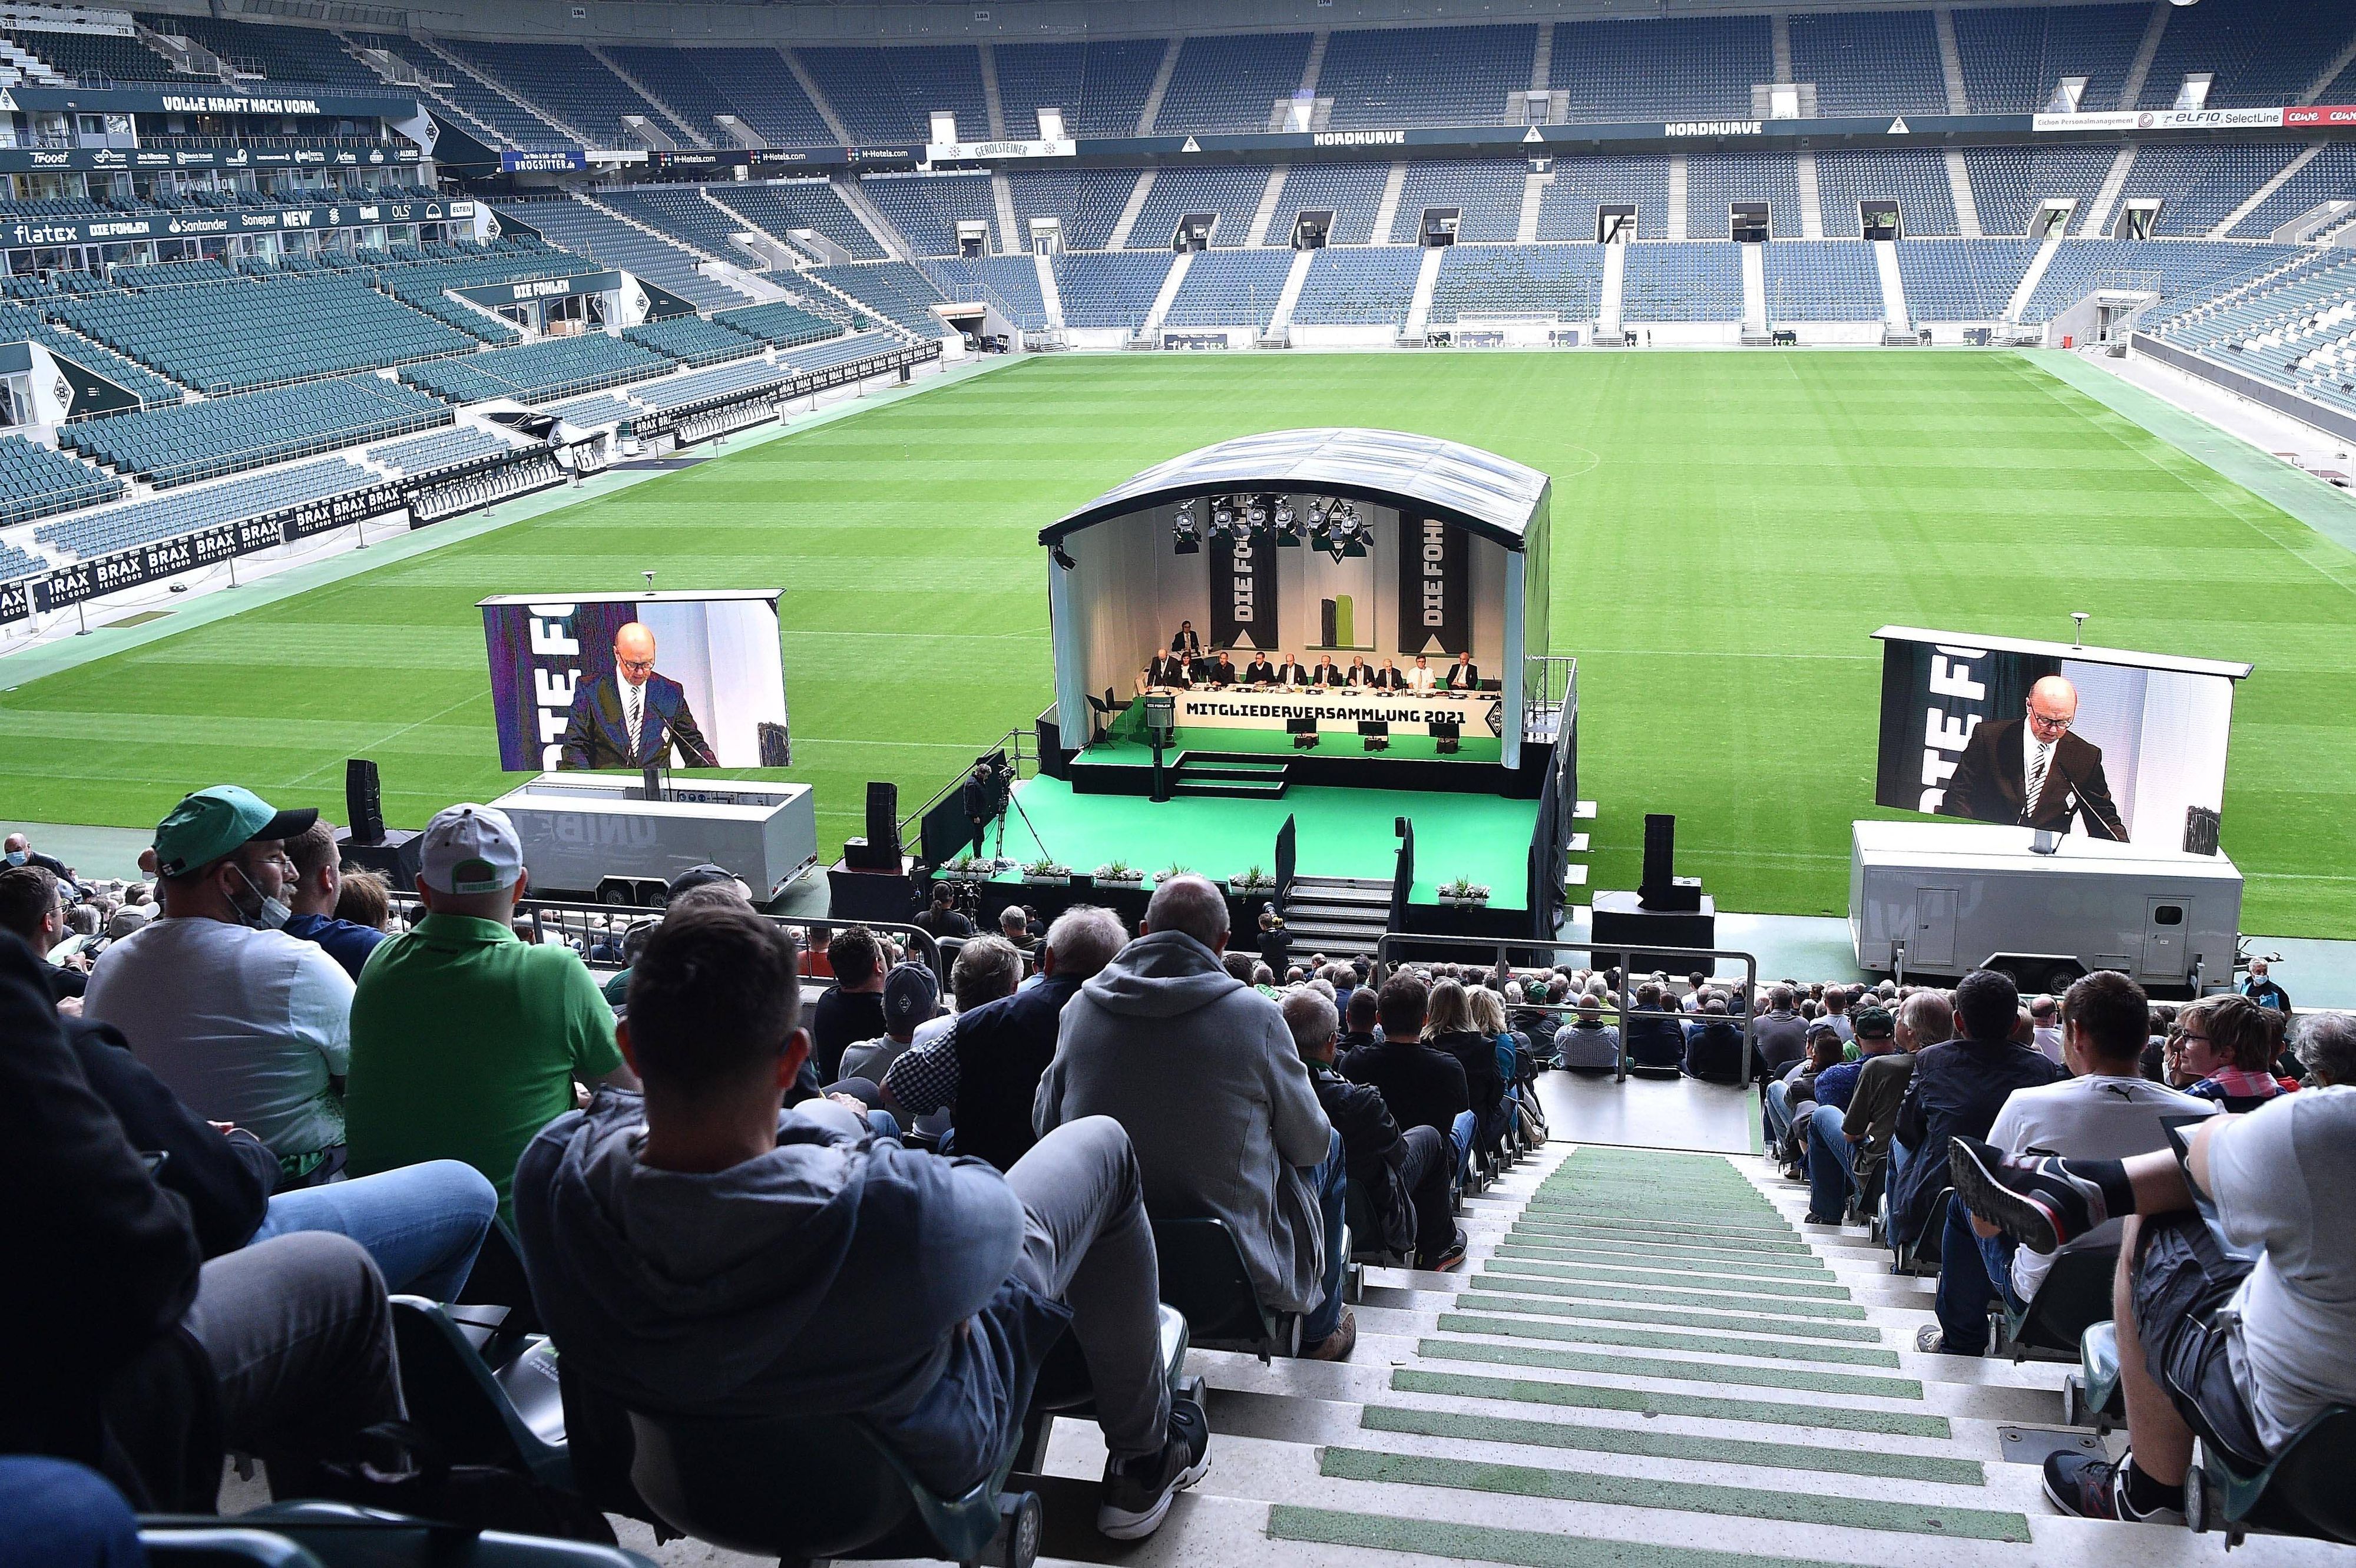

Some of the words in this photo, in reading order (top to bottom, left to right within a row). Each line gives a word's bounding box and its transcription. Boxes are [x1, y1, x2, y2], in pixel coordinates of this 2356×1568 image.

[162, 96, 207, 111] VOLLE
[208, 97, 249, 113] KRAFT
[250, 98, 283, 113] NACH
[283, 100, 320, 114] VORN.
[2061, 118, 2133, 126] Personalmanagement
[2225, 113, 2279, 123] SelectLine
[2288, 111, 2319, 121] cewe
[1664, 121, 1763, 137] NORDKURVE
[1313, 130, 1405, 145] NORDKURVE
[763, 151, 806, 161] H-Hotels.com
[862, 150, 908, 158] H-Hotels.com
[975, 143, 1028, 157] GEROLSTEINER
[514, 160, 575, 170] BROGSITTER.de
[674, 155, 716, 164] H-Hotels.com
[181, 219, 228, 232] Santander
[241, 214, 276, 227] Sonepar
[89, 223, 110, 236] DIE
[110, 221, 150, 235] FOHLEN
[513, 285, 532, 299] DIE
[532, 279, 570, 297] FOHLEN
[812, 373, 828, 385] BRAX
[829, 369, 843, 381] BRAX
[796, 378, 811, 389] BRAX
[636, 417, 657, 433] BRAX
[368, 487, 399, 507] BRAX
[333, 496, 366, 516] BRAX
[370, 504, 384, 513] FEEL
[386, 499, 401, 509] GOOD
[296, 506, 331, 527] BRAX
[335, 514, 350, 523] FEEL
[351, 509, 367, 518] GOOD
[241, 520, 279, 542] BRAX
[315, 519, 332, 529] GOOD
[196, 532, 236, 554] BRAX
[243, 540, 260, 549] FEEL
[262, 534, 280, 544] GOOD
[148, 544, 190, 568] BRAX
[198, 552, 216, 562] FEEL
[217, 546, 237, 556] GOOD
[97, 557, 141, 582] BRAX
[150, 565, 168, 575] FEEL
[171, 559, 191, 569] GOOD
[100, 578, 118, 589] FEEL
[121, 572, 143, 583] GOOD
[51, 594, 65, 603] EEL
[68, 587, 91, 598] GOOD
[1233, 577, 1253, 622] DIE
[3, 605, 27, 617] GOOD
[1423, 580, 1443, 627] DIE
[1186, 703, 1420, 723] MITGLIEDERVERSAMMLUNG
[1424, 710, 1466, 725] 2021
